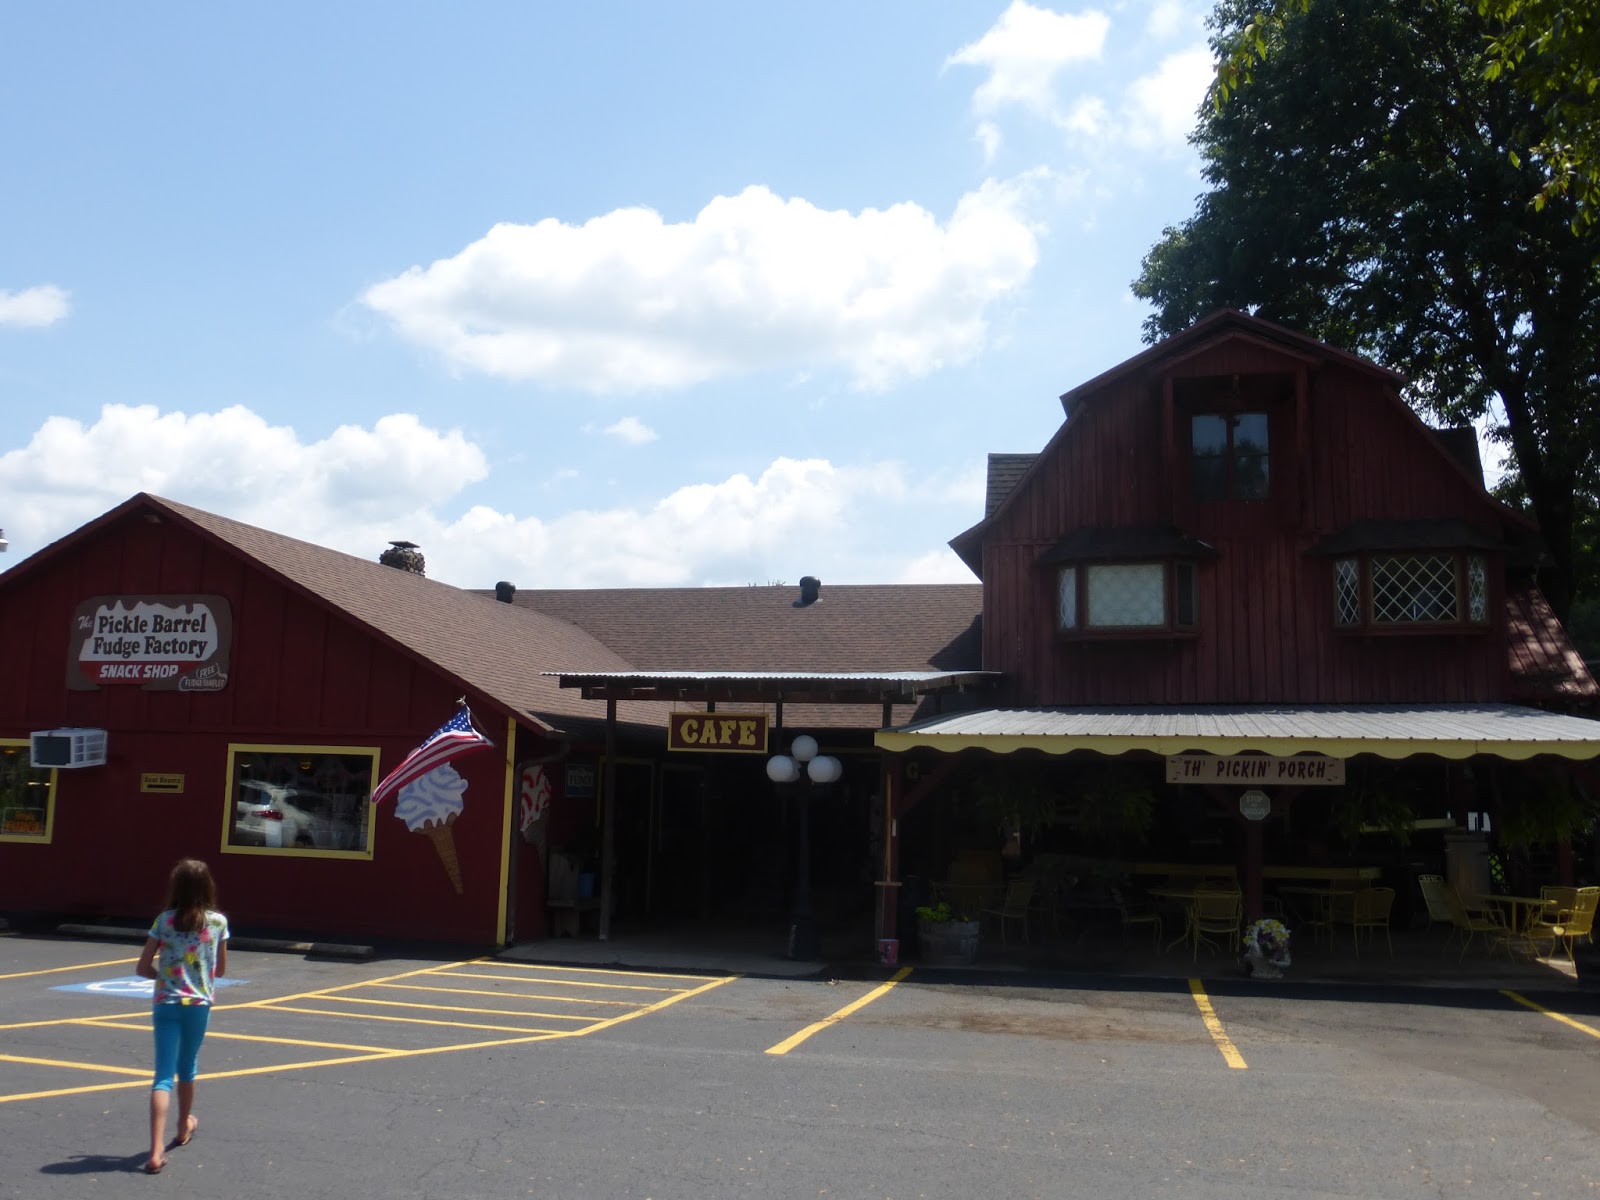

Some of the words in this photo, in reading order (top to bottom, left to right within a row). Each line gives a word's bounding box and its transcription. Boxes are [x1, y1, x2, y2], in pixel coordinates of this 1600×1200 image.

[77, 615, 94, 630] The
[98, 615, 148, 634] Pickle
[152, 613, 207, 633] Barrel
[93, 636, 141, 659] Fudge
[144, 635, 208, 659] Factory
[99, 664, 142, 679] SNACK
[143, 664, 179, 679] SHOP
[199, 666, 216, 679] FREE
[679, 718, 757, 746] CAFE
[1184, 760, 1206, 777] TH'
[1216, 760, 1271, 779] PICKIN'
[1278, 761, 1326, 779] PORCH
[1246, 795, 1264, 803] STOP
